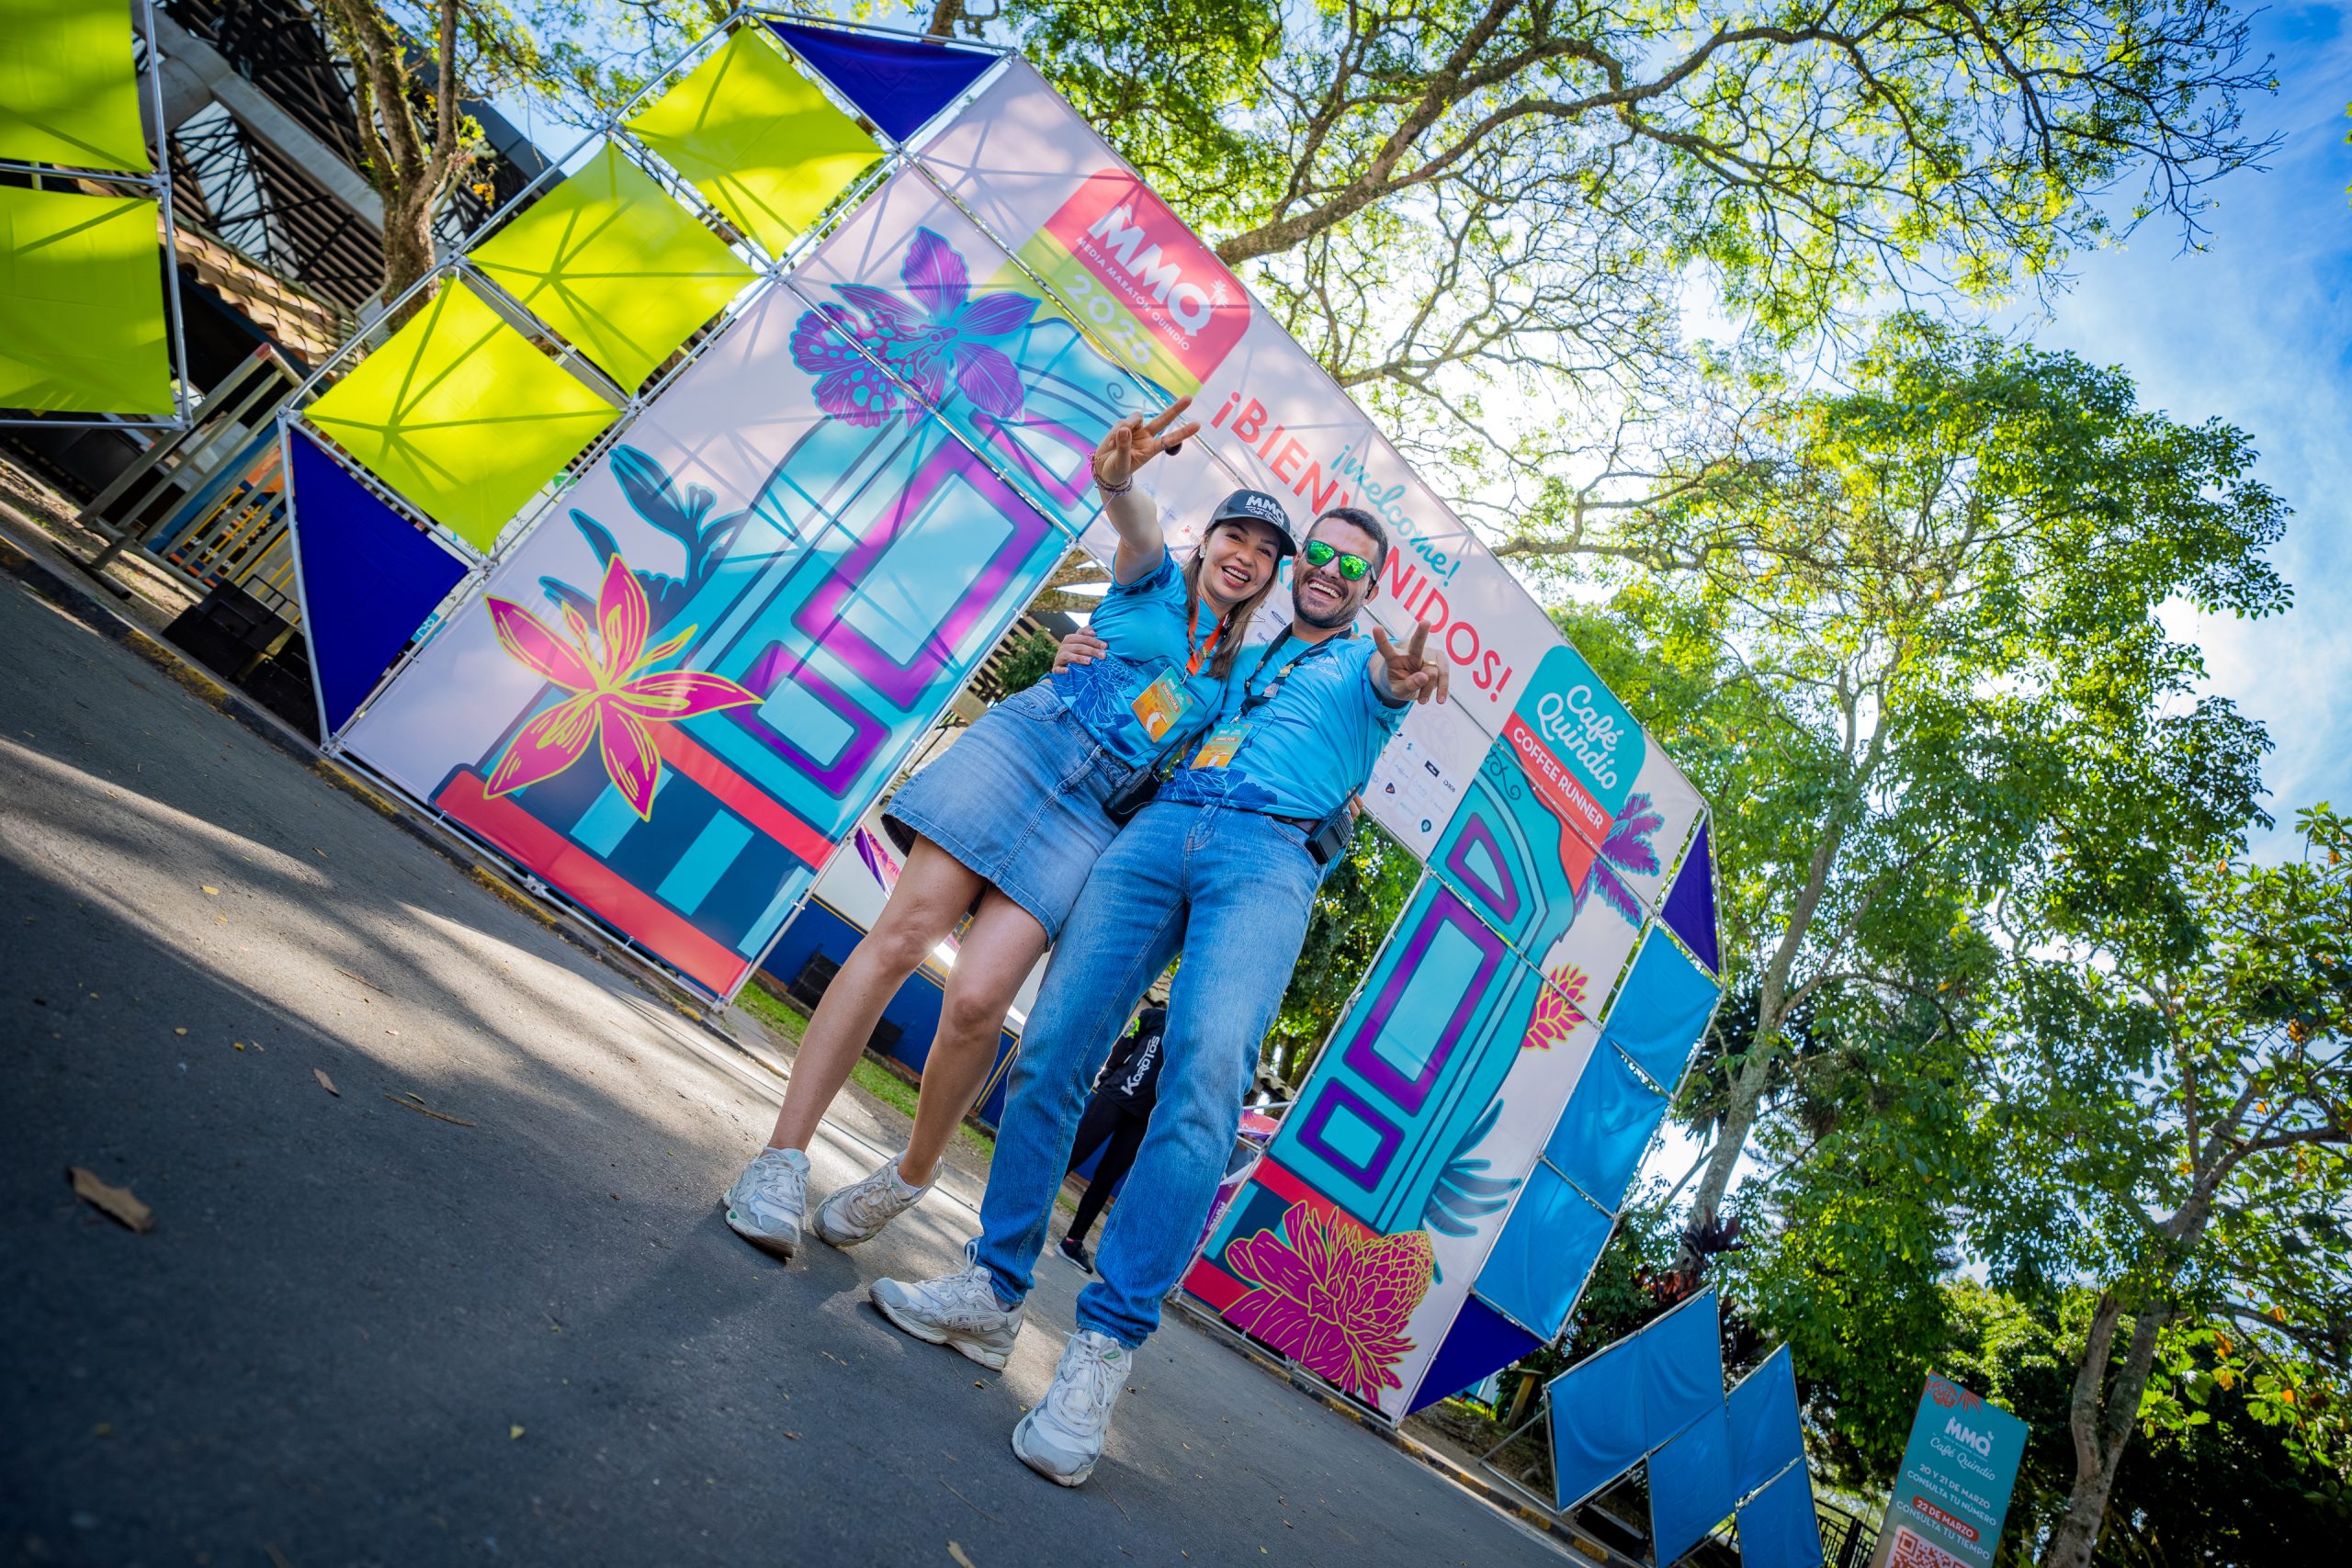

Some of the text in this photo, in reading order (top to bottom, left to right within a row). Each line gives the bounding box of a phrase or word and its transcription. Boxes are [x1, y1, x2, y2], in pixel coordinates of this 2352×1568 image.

[1075, 236, 1191, 351] MEDIA MARATÓN QUINDÍO
[1087, 203, 1213, 337] MMQ
[1064, 275, 1154, 365] 2026
[1210, 391, 1512, 703] ¡BIENNIDOS!
[1536, 692, 1618, 790] Quindío
[1566, 684, 1624, 751] Café
[1513, 727, 1604, 830] COFFEE RUNNER
[1930, 1437, 1955, 1458] Café
[1957, 1452, 1996, 1481] Quindío
[1944, 1416, 1992, 1457] MMQ
[1906, 1471, 1996, 1526] CONSULTA TU NÚMERO
[1916, 1500, 1974, 1538] 22 DE MARZO
[1919, 1463, 1991, 1509] 20 Y 21 DE MARZO
[1895, 1500, 1990, 1561] CONSULTA TU TIEMPO
